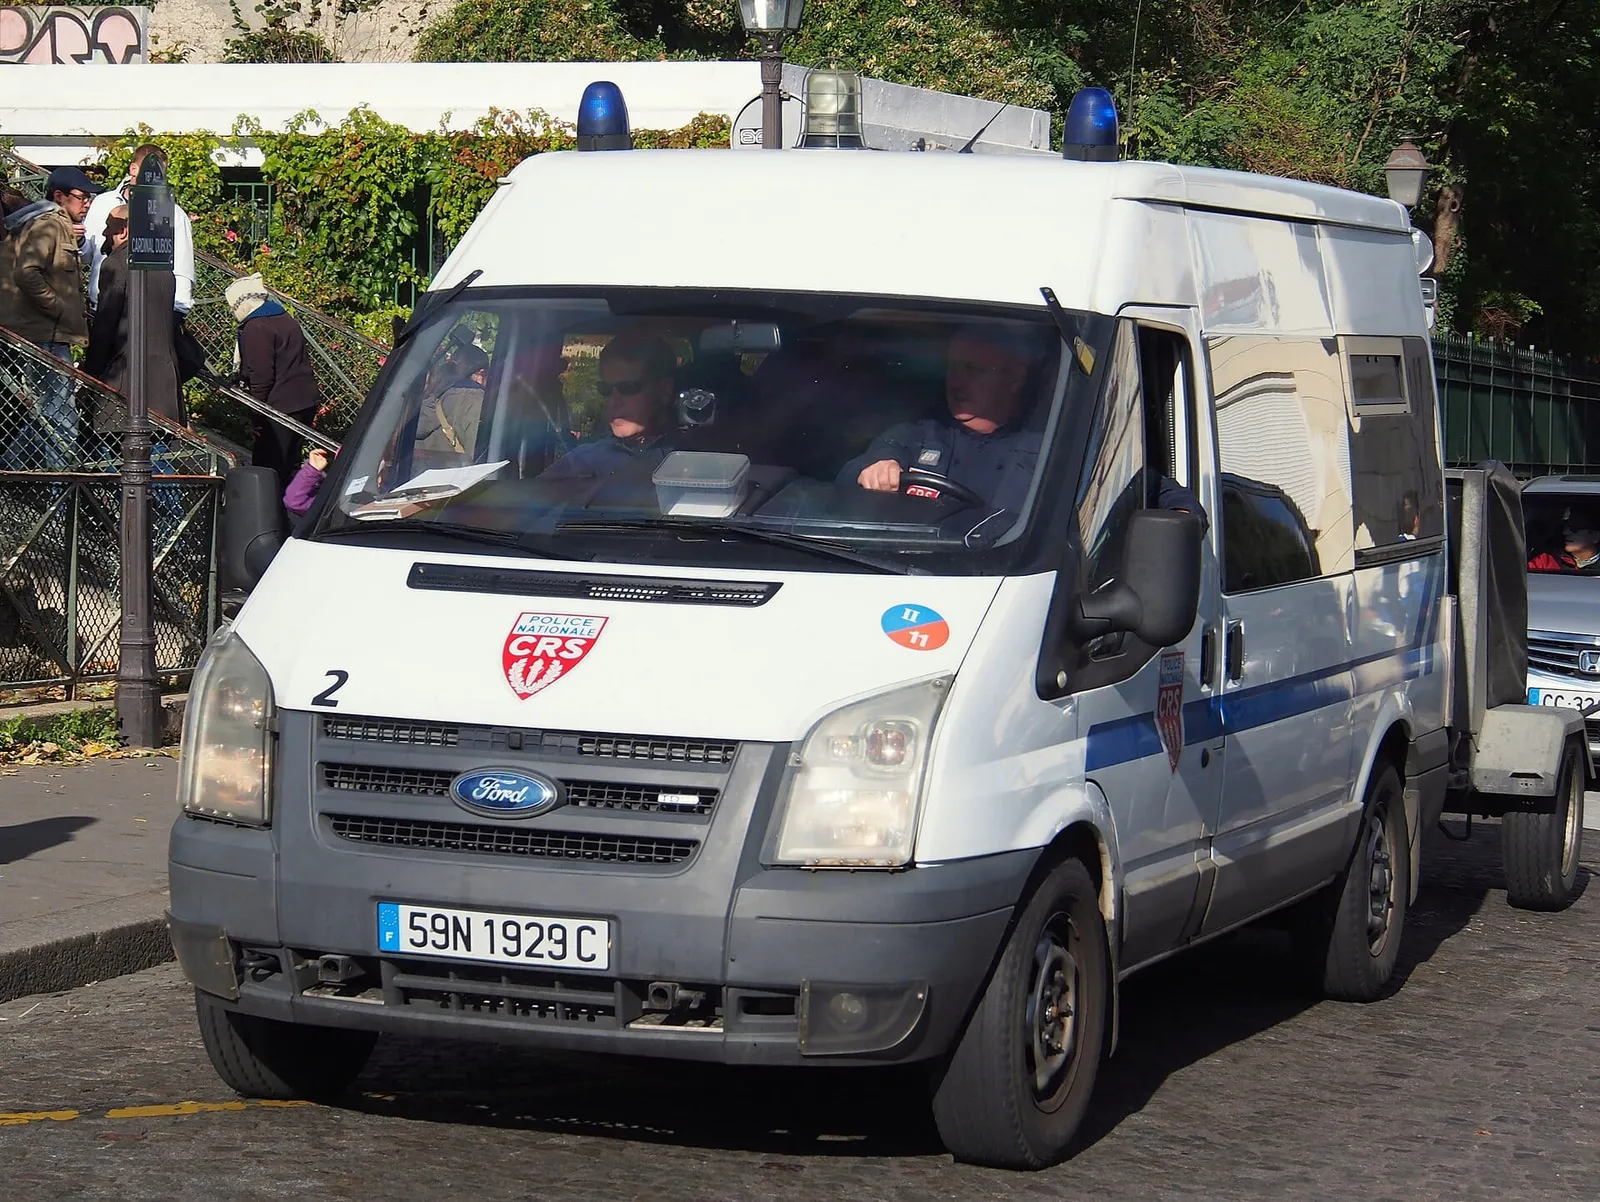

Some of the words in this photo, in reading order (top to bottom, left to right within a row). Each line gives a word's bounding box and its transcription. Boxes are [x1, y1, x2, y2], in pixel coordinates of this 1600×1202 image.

[147, 200, 157, 214] RUE
[131, 237, 154, 253] CARDINAL
[155, 238, 172, 253] DUBOIS
[517, 624, 596, 637] NATIONALE
[529, 615, 594, 627] POLICE
[508, 635, 588, 660] CRS
[908, 630, 929, 648] 11
[310, 669, 349, 708] 2
[1159, 688, 1181, 718] CRS
[472, 777, 530, 803] Ford
[385, 931, 394, 943] F
[408, 911, 472, 953] 59N
[484, 918, 567, 961] 1929
[576, 925, 597, 963] C
